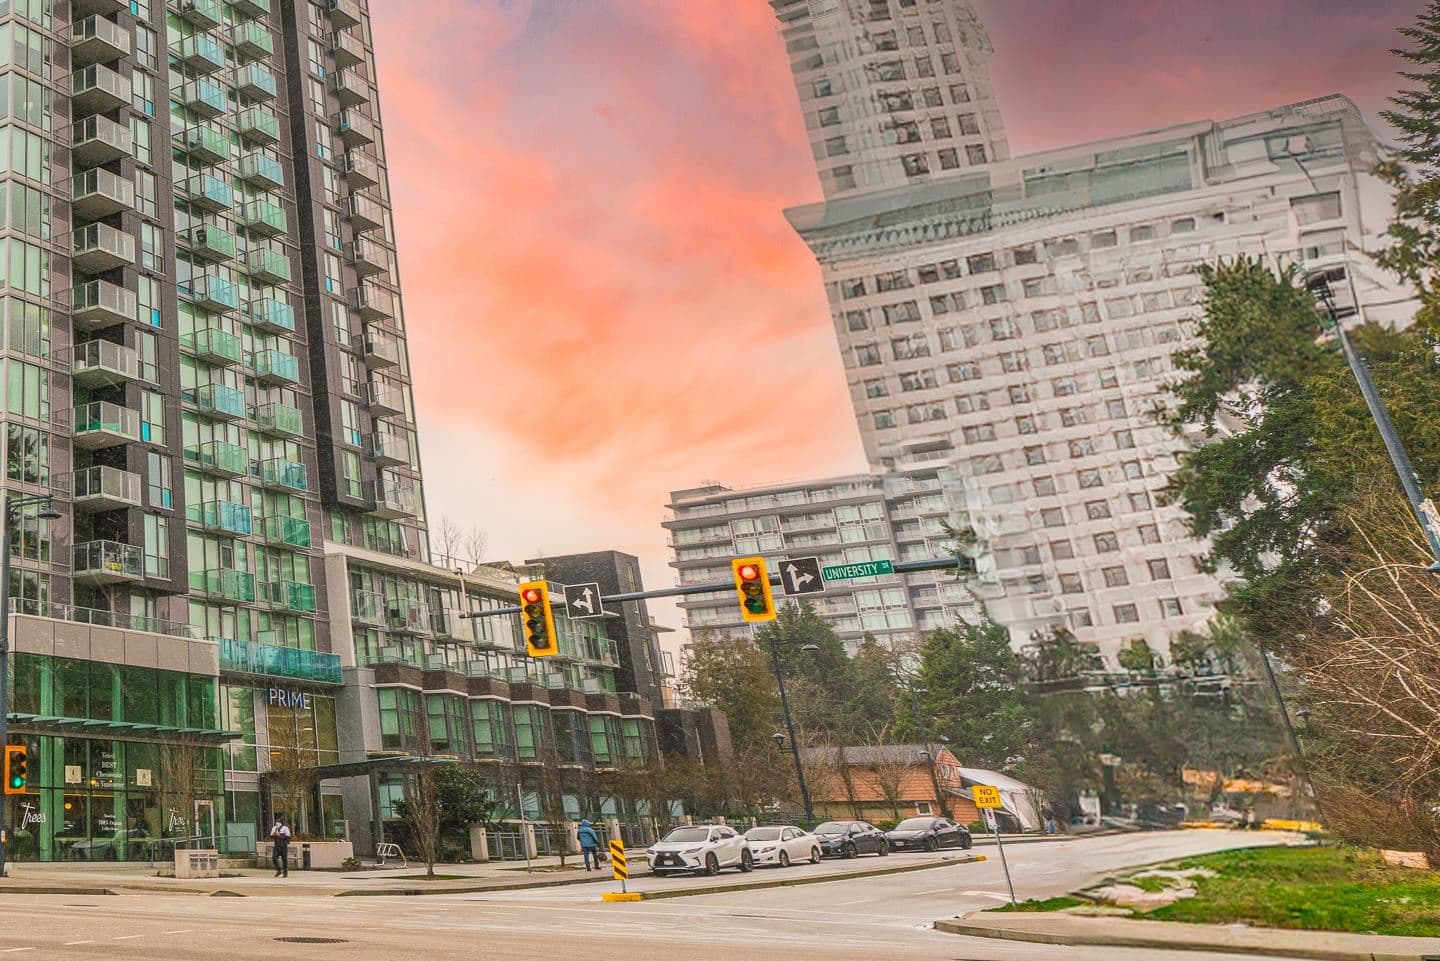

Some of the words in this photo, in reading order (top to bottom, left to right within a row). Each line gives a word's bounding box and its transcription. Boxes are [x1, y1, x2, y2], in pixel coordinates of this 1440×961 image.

[825, 563, 878, 579] UNIVERSITY
[269, 688, 312, 710] PRIME
[101, 761, 117, 769] BEST
[21, 801, 47, 830] Trees
